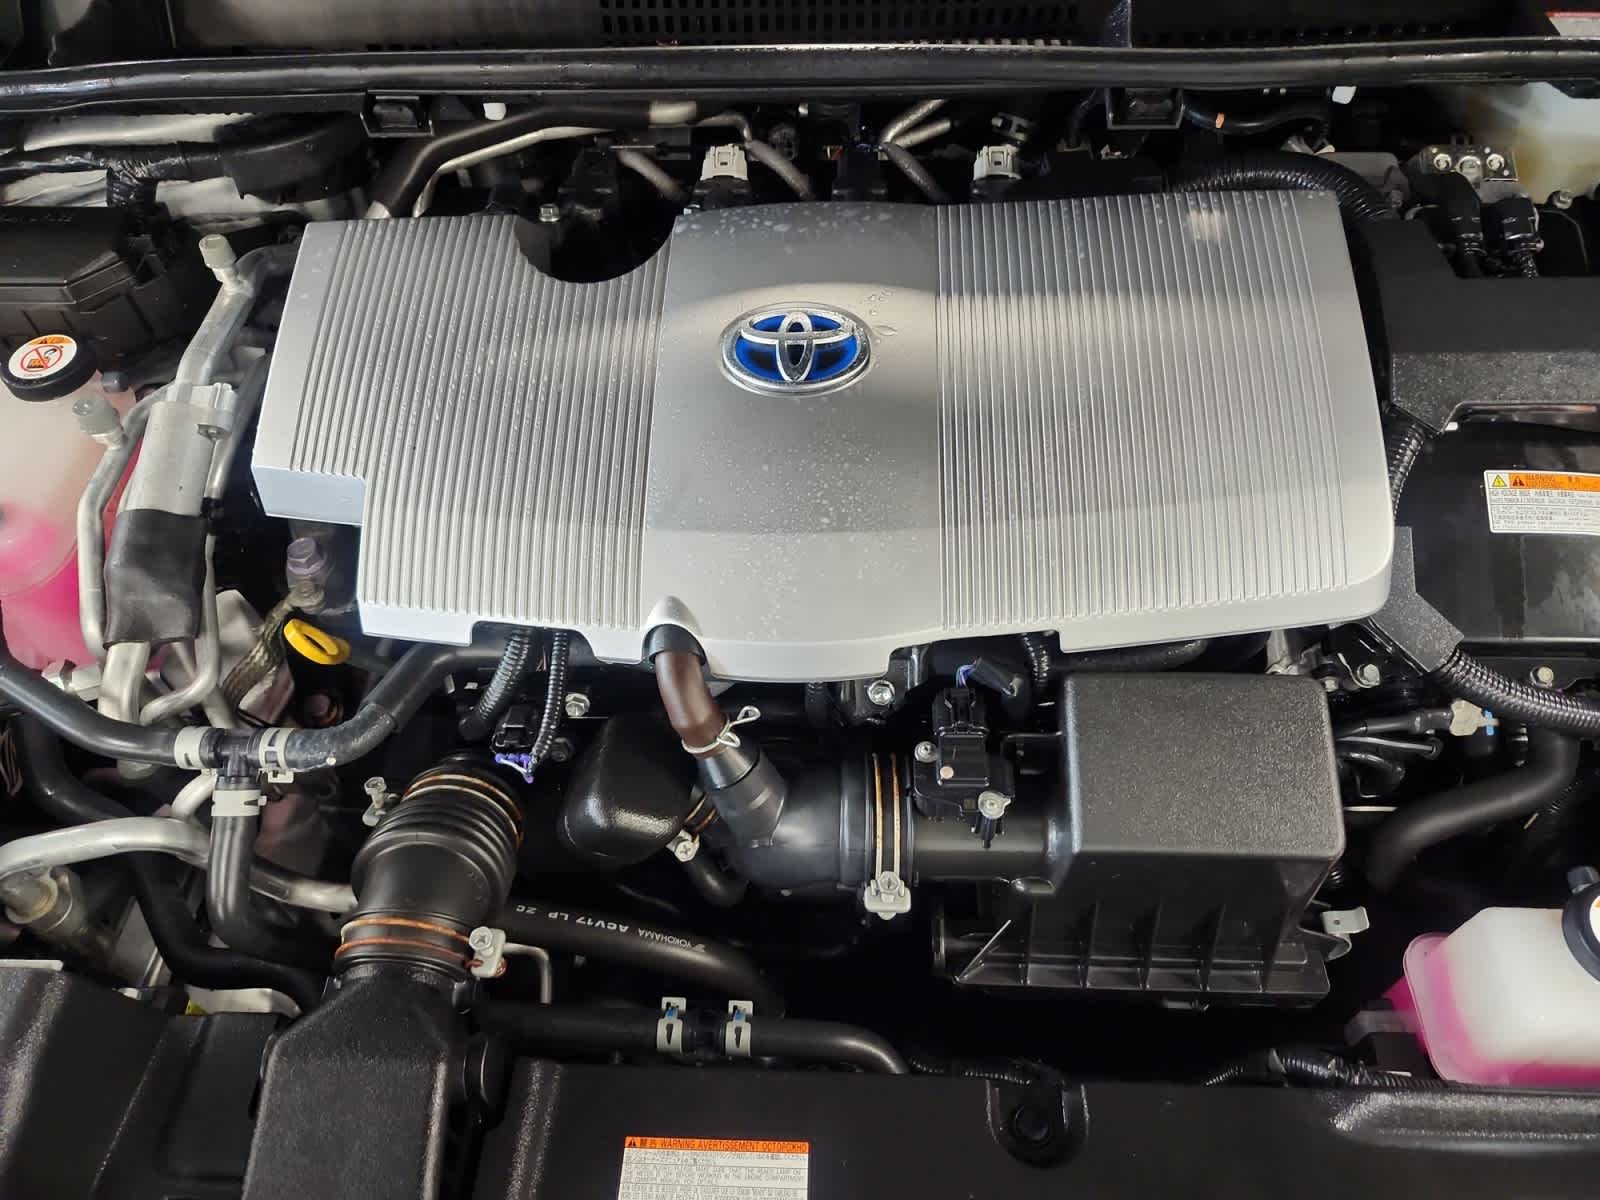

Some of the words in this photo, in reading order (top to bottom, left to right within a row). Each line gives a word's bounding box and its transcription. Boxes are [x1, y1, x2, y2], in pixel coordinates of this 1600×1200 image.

[548, 911, 569, 921] LP
[575, 916, 629, 933] ACV17
[637, 928, 692, 948] YOKOHAMA
[661, 1138, 695, 1149] WARNING
[698, 1140, 758, 1151] AVERTISSEMENT
